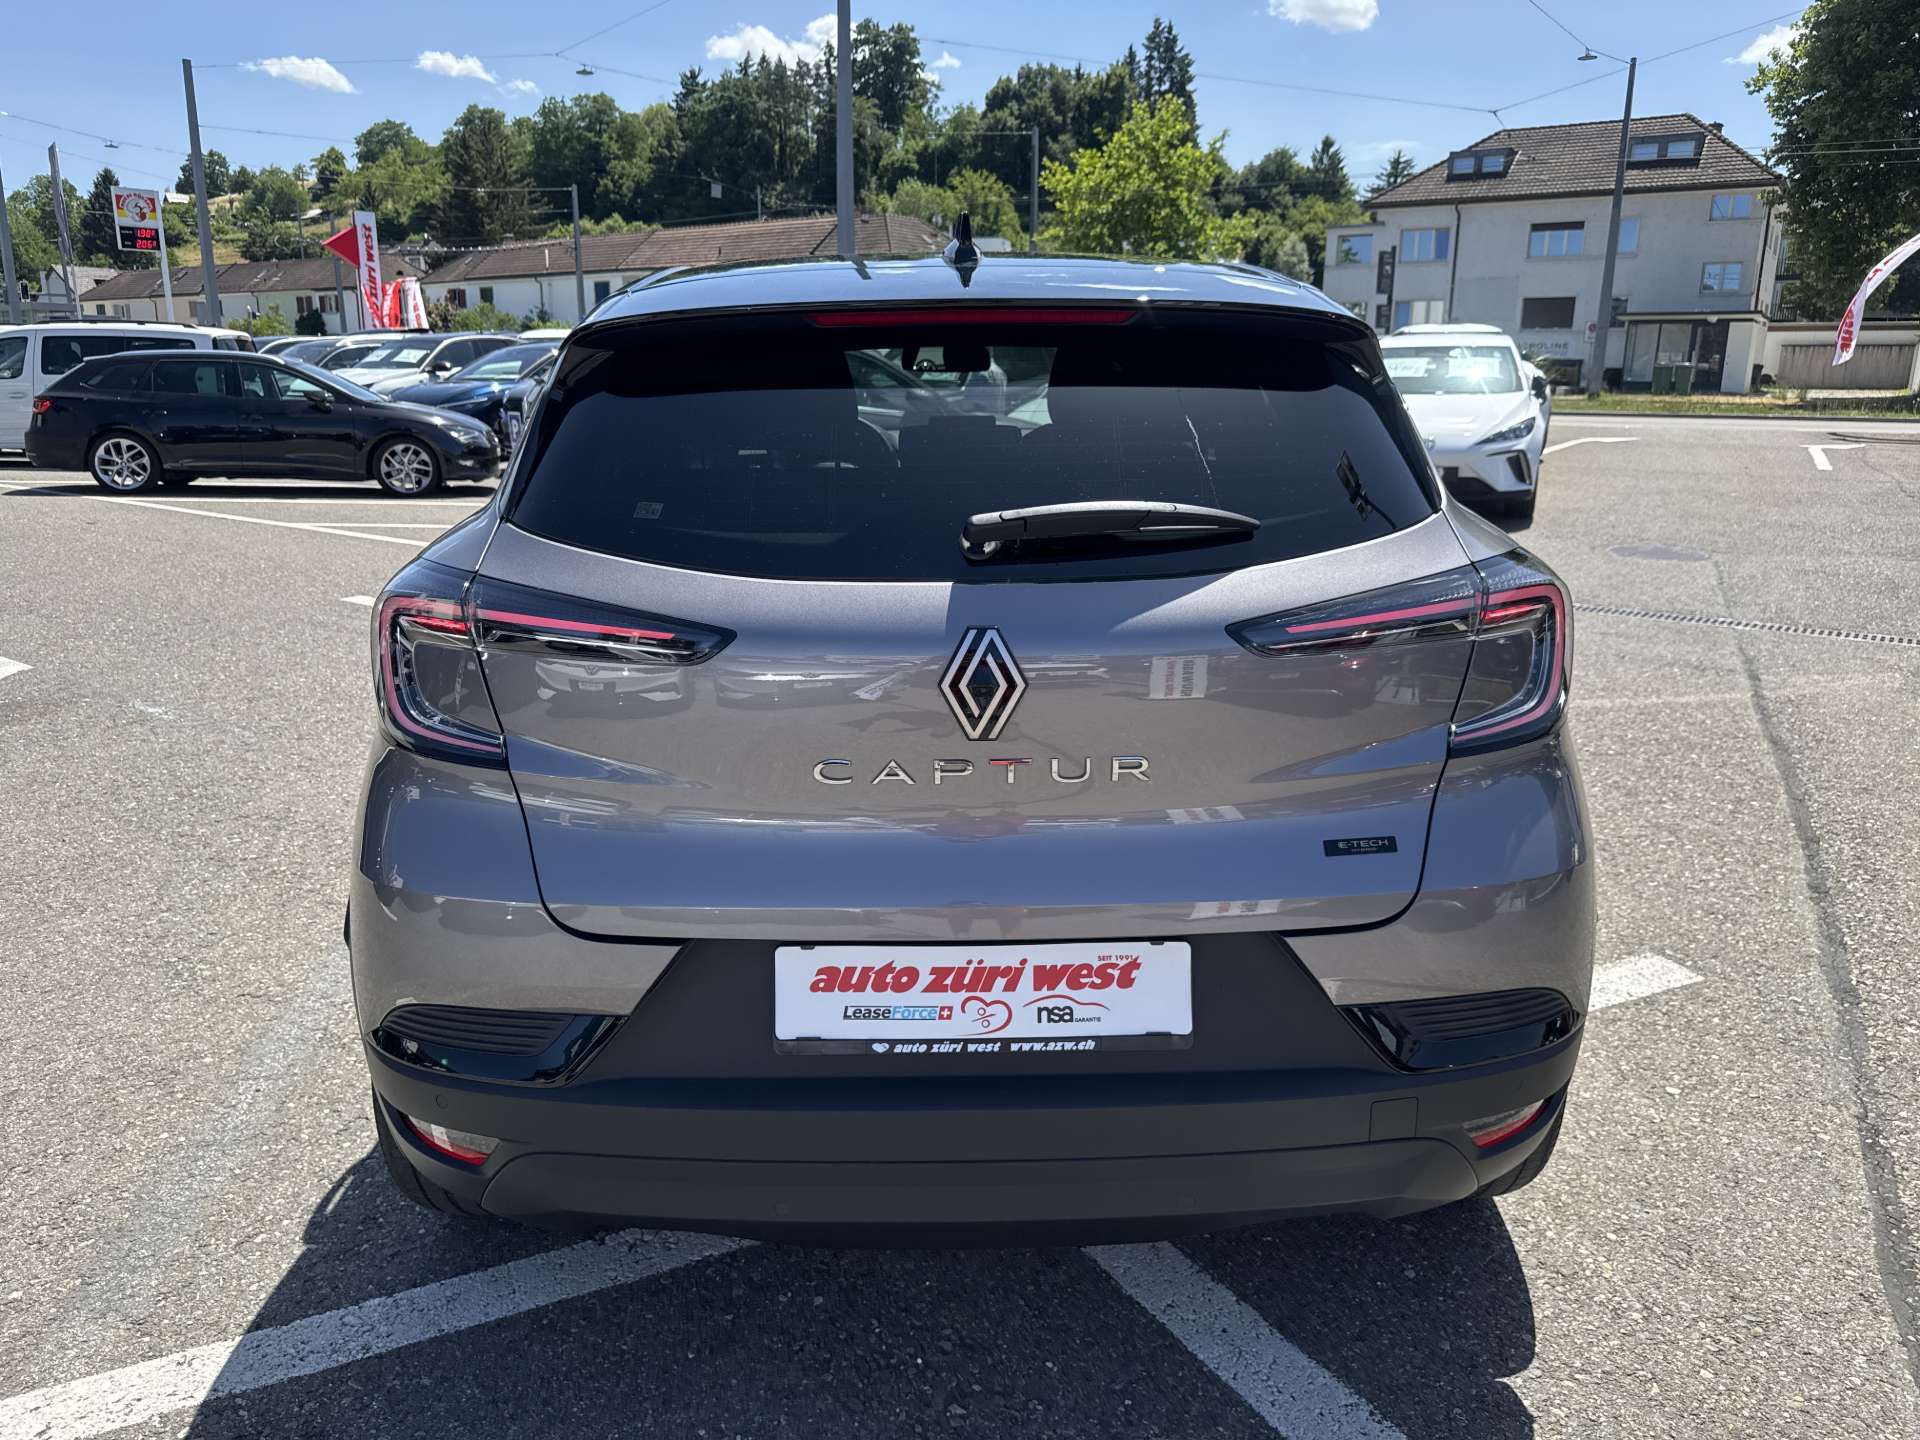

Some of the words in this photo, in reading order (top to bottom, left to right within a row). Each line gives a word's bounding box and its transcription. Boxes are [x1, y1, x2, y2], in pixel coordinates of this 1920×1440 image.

[813, 755, 1150, 785] CAPTUR
[1337, 839, 1389, 849] E-TECH
[809, 959, 920, 993] auto
[921, 957, 1028, 993] züri
[1033, 955, 1142, 991] west
[843, 1005, 937, 1020] LeaseForce
[1037, 1006, 1074, 1023] nsa
[893, 1042, 927, 1053] auto
[930, 1041, 962, 1053] züri
[967, 1041, 1001, 1053] west
[1010, 1040, 1096, 1053] www.azw.ch
